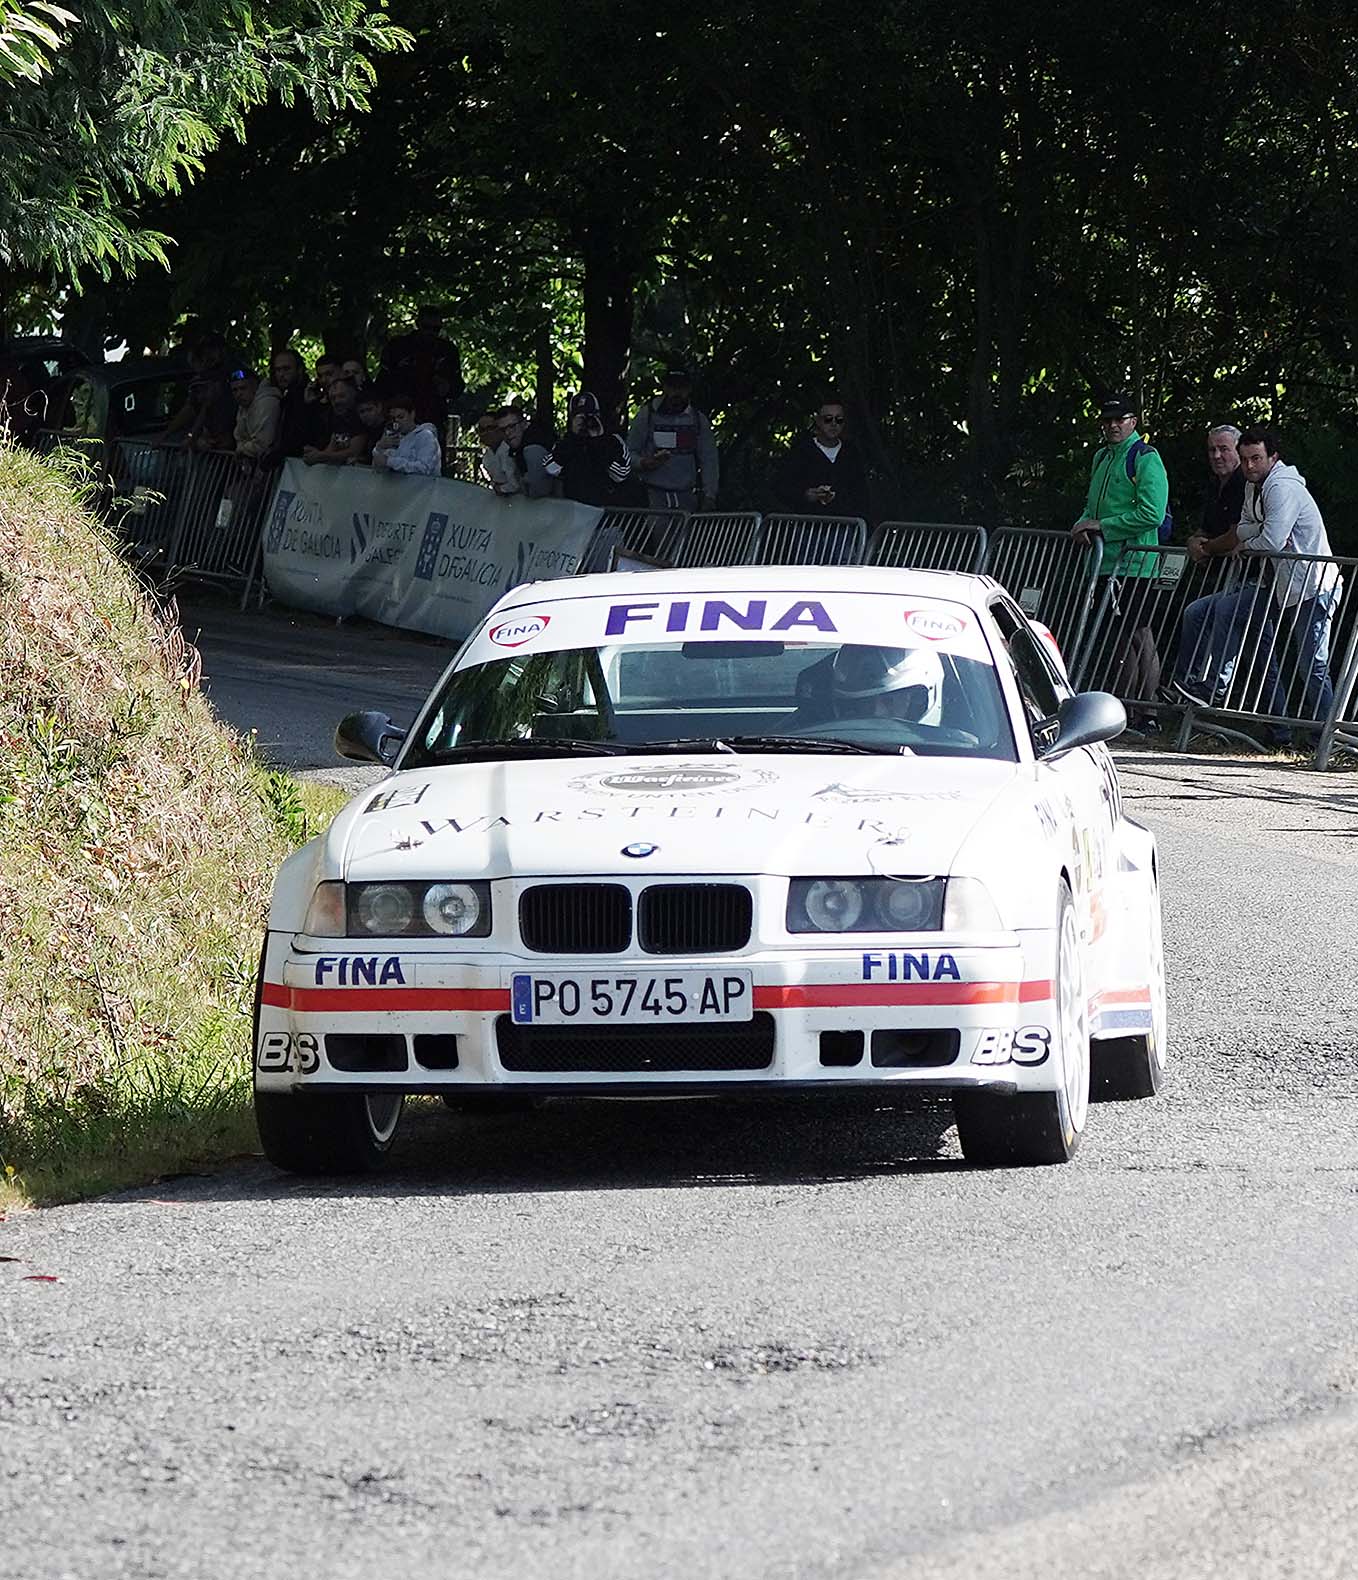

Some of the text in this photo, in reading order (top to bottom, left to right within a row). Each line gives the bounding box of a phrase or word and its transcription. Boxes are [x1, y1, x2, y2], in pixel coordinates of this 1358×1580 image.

[496, 623, 540, 640] FINA
[605, 600, 838, 636] FINA
[911, 616, 957, 633] FINA
[420, 806, 893, 836] WARSTEINER
[315, 957, 406, 985] FINA
[862, 953, 961, 981] FINA
[535, 977, 745, 1016] PO 5745 AP
[970, 1025, 1051, 1077] BBS
